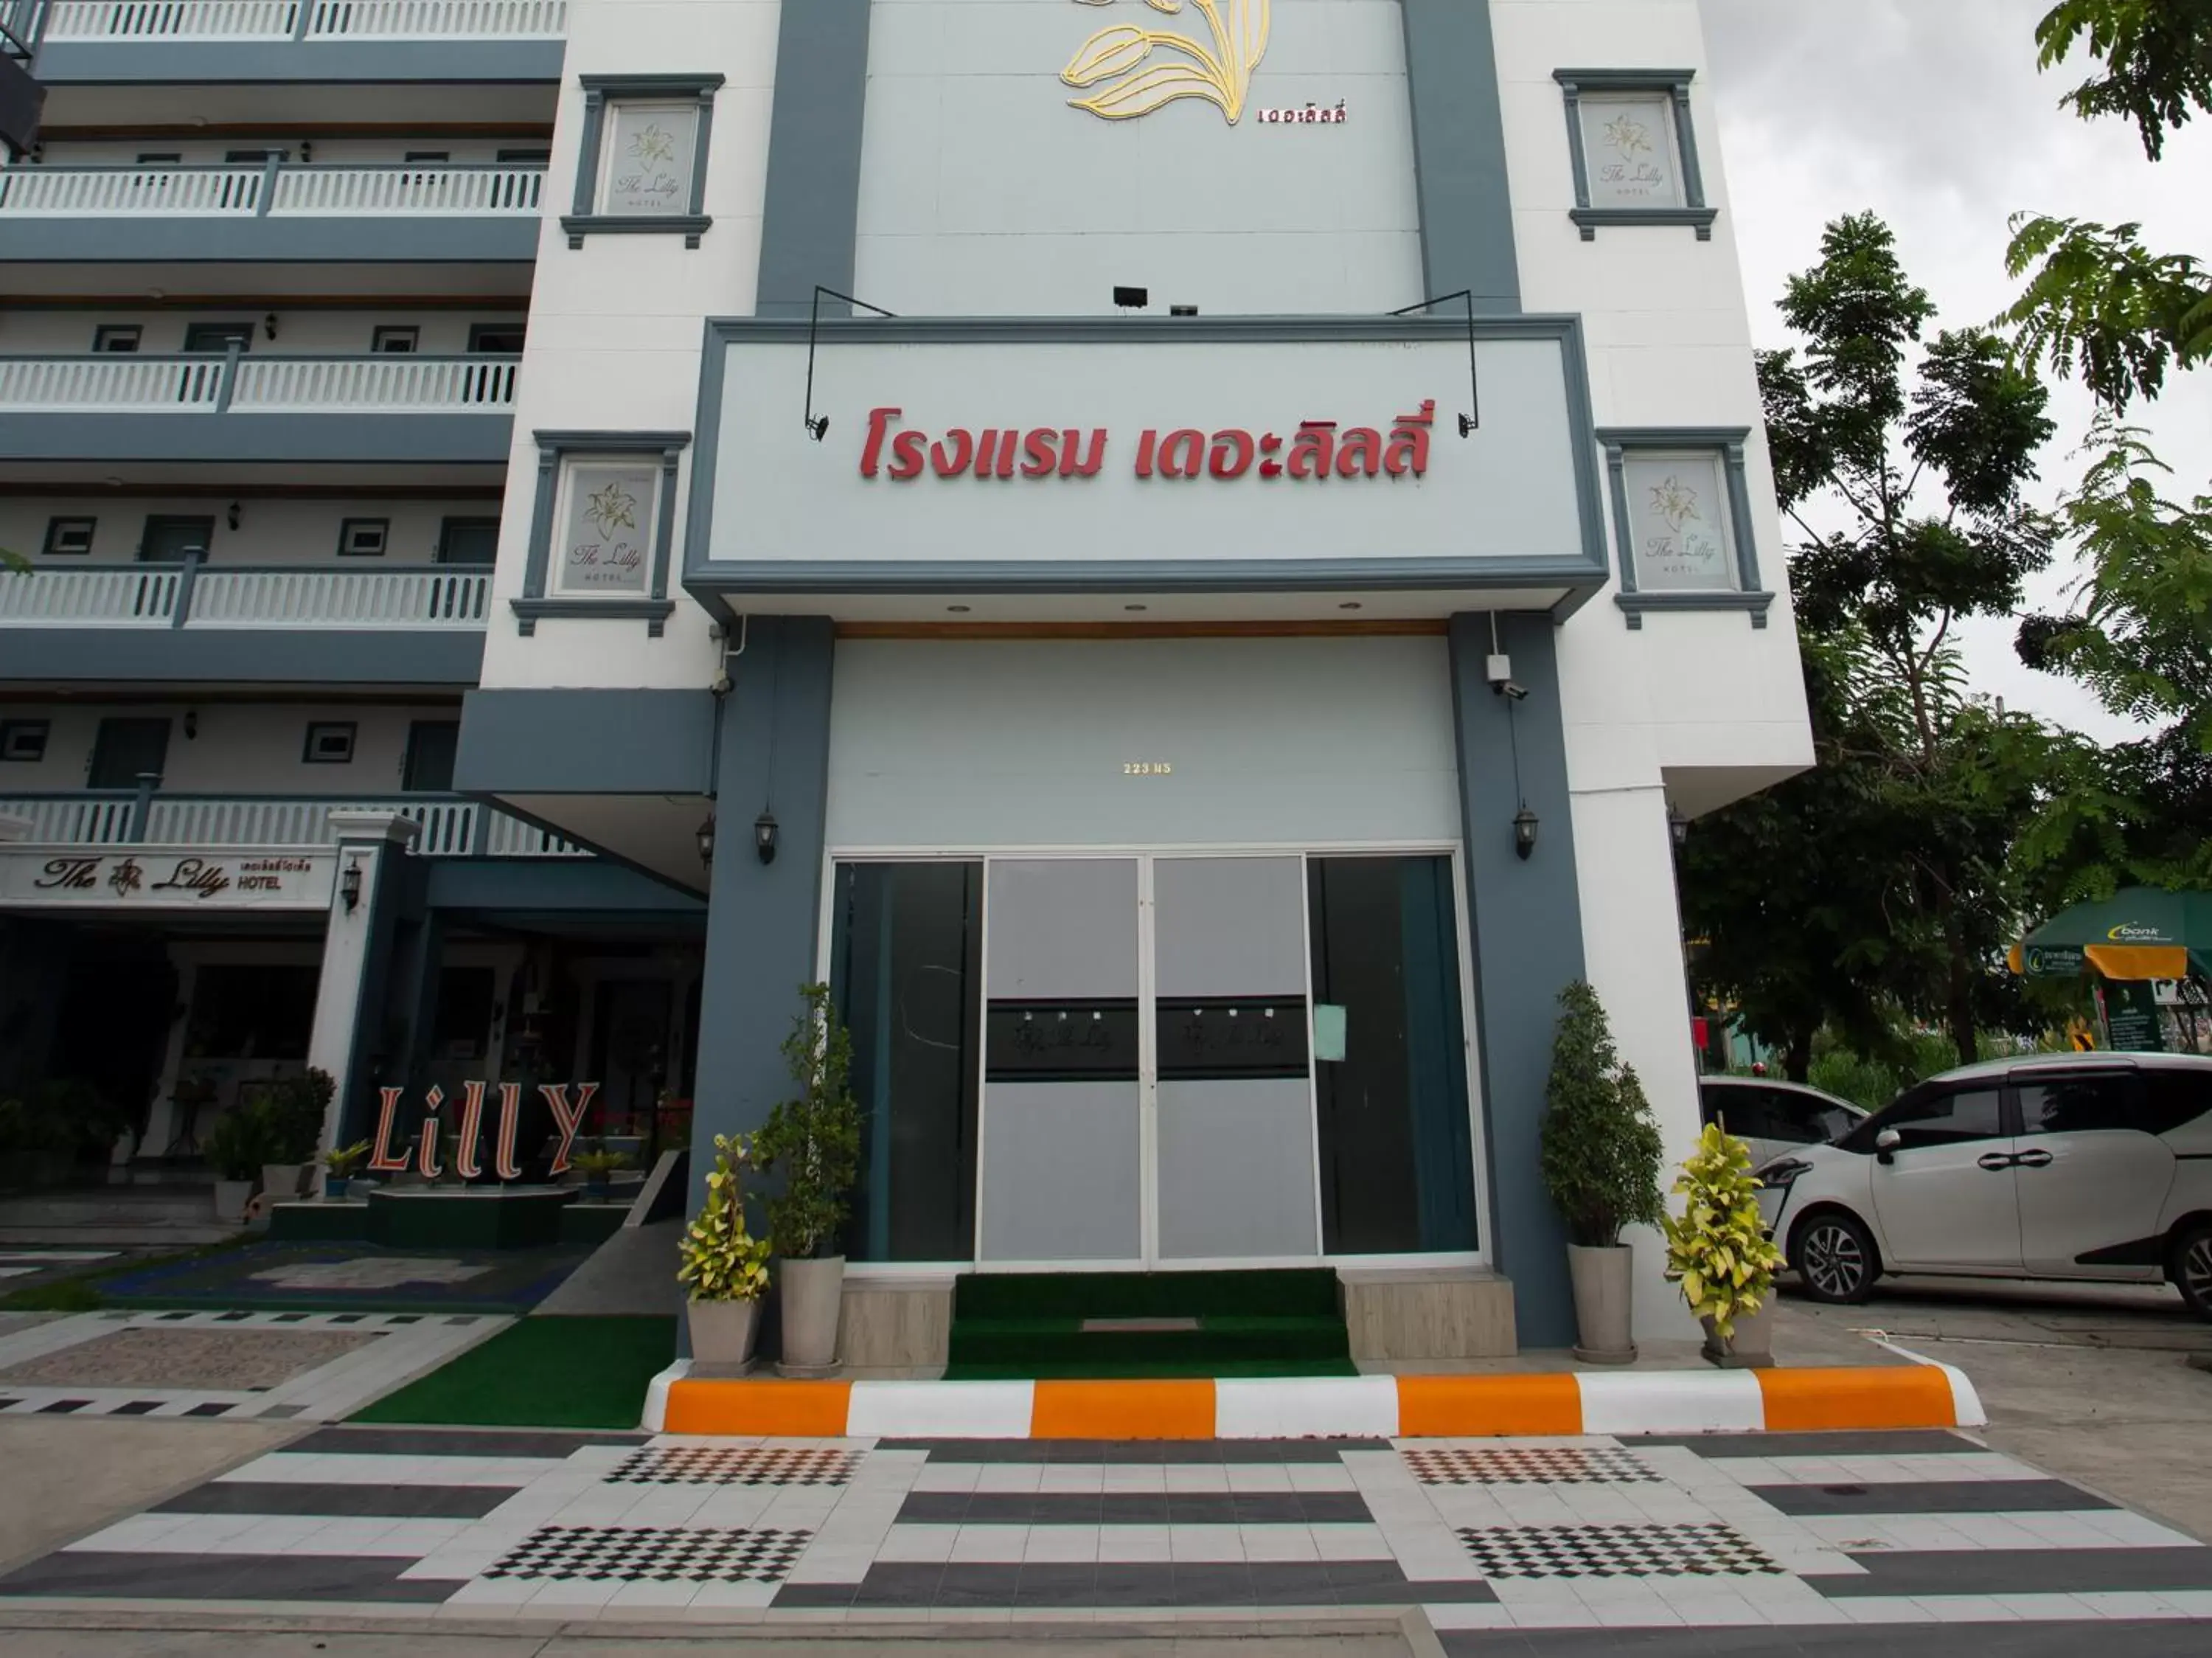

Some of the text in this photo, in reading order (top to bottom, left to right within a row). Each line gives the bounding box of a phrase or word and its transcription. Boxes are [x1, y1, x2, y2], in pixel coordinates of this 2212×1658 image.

[1257, 98, 1346, 123] เดอะลิลลี่
[615, 173, 679, 198] The Lilly
[1599, 162, 1663, 187] The Lilly
[859, 399, 1436, 479] โรงแรม เดอะลิลลี่
[570, 542, 641, 572] The Lilly
[1645, 533, 1716, 564] The Lilly
[585, 573, 622, 581] HOTEL
[34, 857, 231, 898] The Lilly
[237, 875, 282, 890] HOTEL
